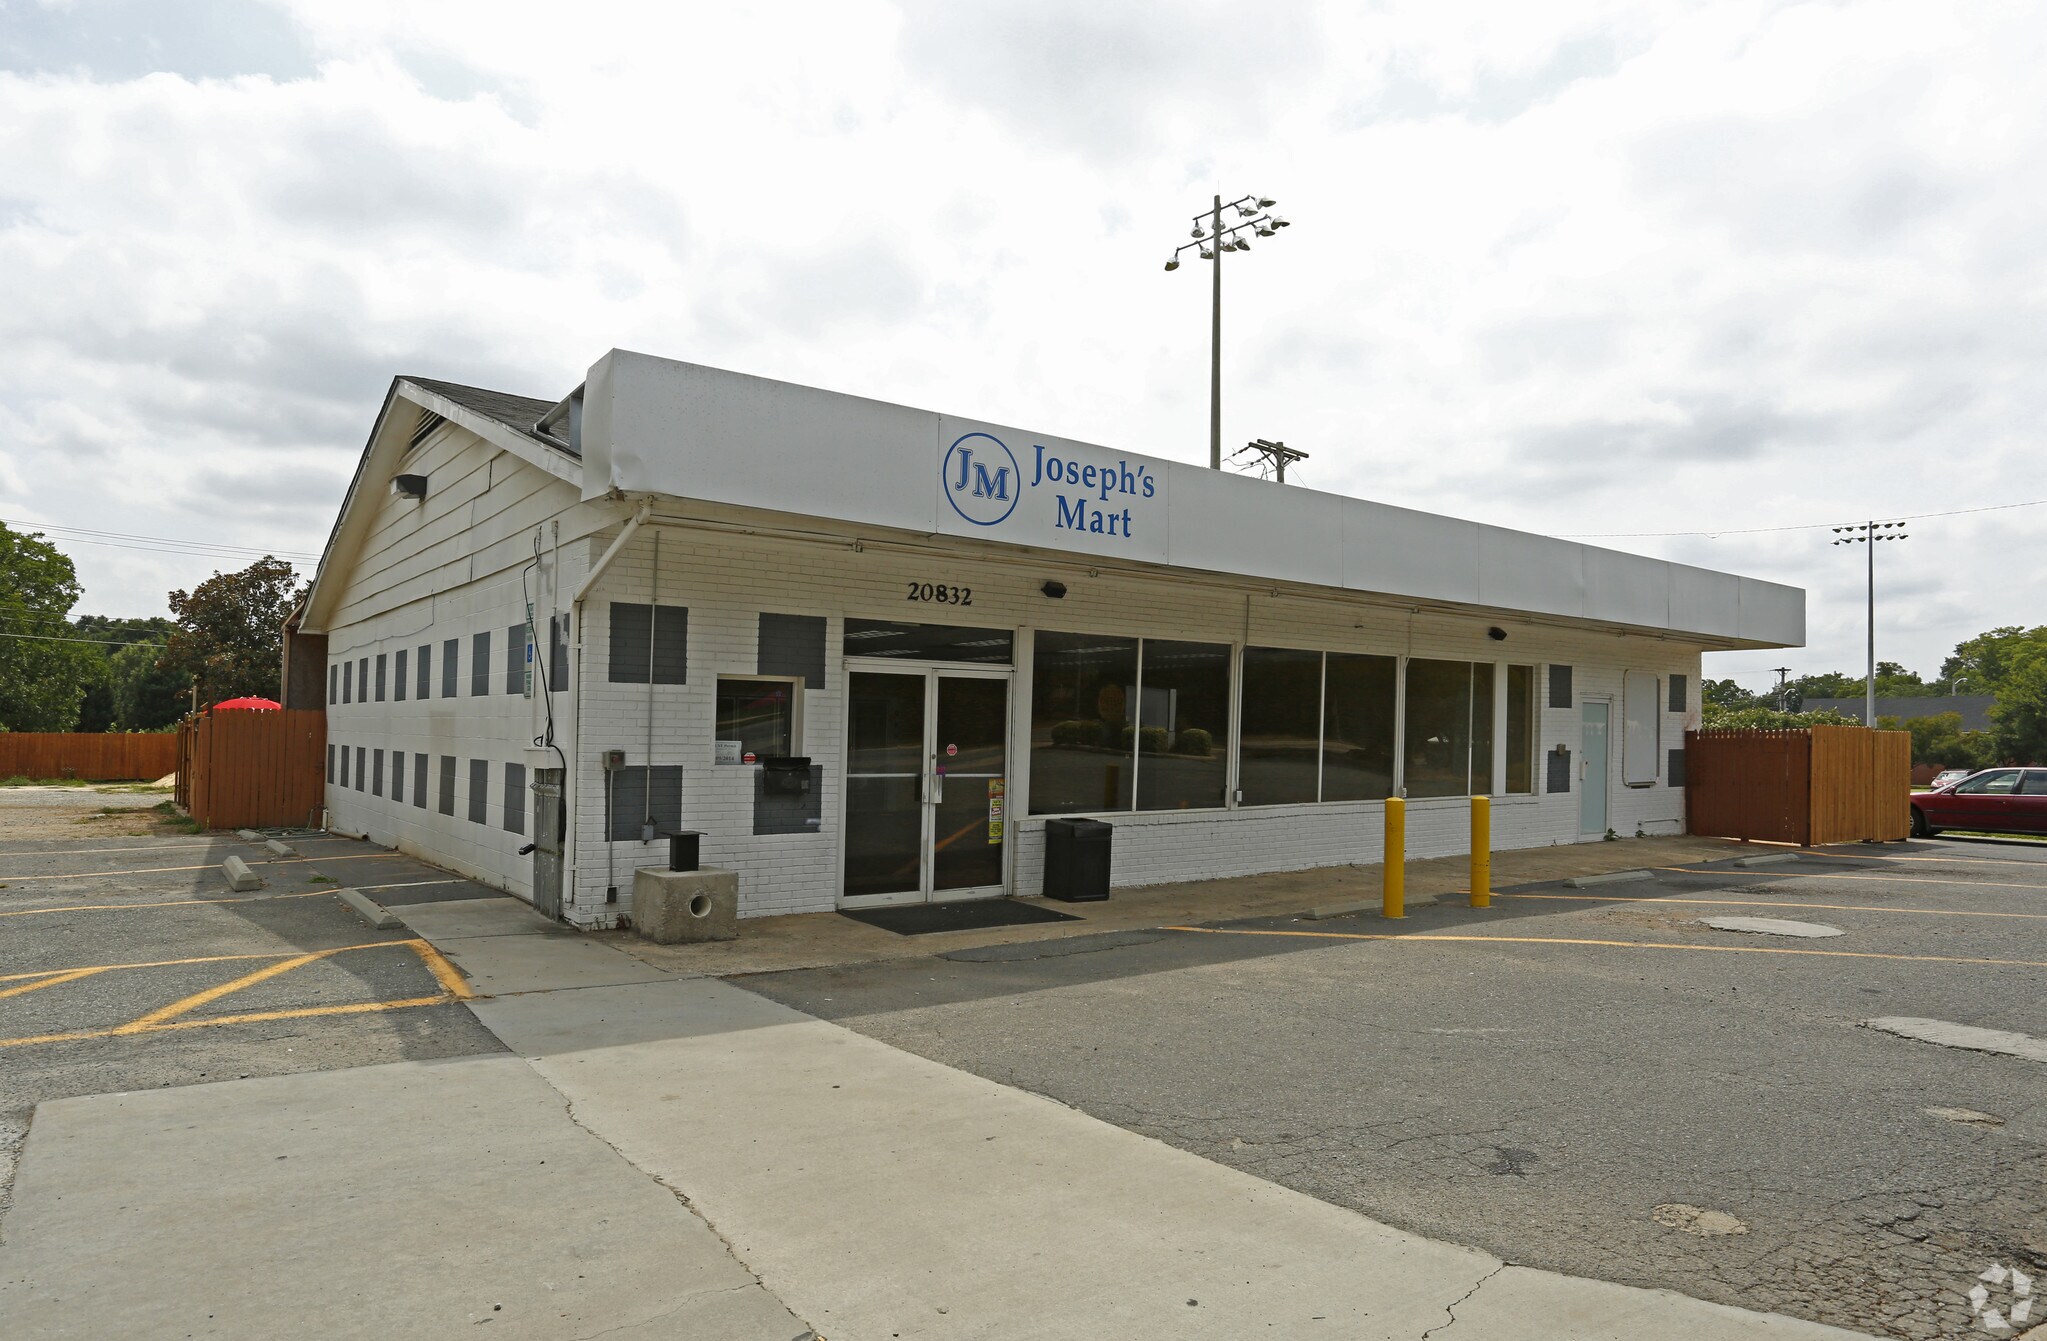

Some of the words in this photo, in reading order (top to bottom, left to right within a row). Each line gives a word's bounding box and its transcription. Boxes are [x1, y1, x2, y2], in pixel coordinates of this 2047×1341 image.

[955, 447, 1010, 501] JM
[1031, 444, 1155, 501] Joseph's
[1055, 494, 1132, 538] Mart
[907, 582, 972, 606] 20832
